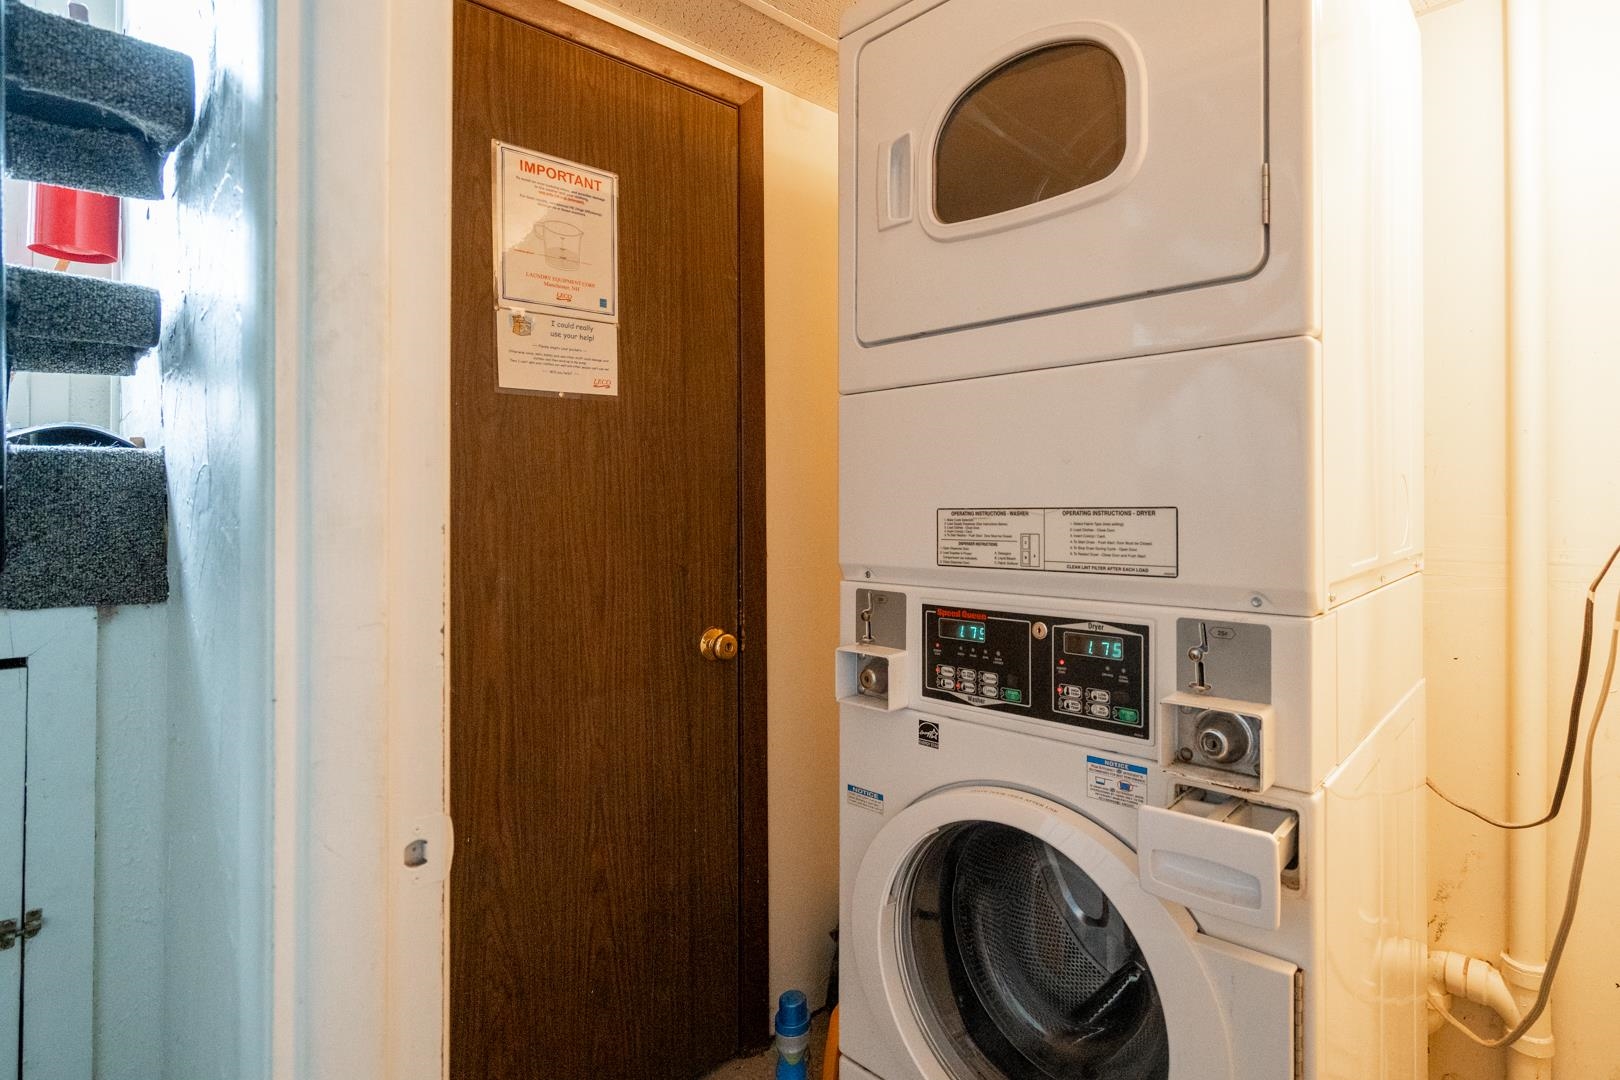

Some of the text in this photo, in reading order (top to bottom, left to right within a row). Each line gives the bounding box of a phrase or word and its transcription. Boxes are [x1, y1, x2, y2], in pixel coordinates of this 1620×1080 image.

[519, 159, 602, 192] IMPORTANT
[525, 272, 551, 282] LAUNDRY
[552, 276, 581, 286] EQUIPMENT
[558, 321, 574, 330] could
[576, 323, 594, 332] really
[579, 334, 595, 342] help!
[937, 608, 987, 620] Speed Queen
[1088, 622, 1104, 631] Dryer
[968, 696, 986, 704] Washer
[1104, 760, 1128, 770] NOTICE
[852, 786, 878, 799] NOTICE
